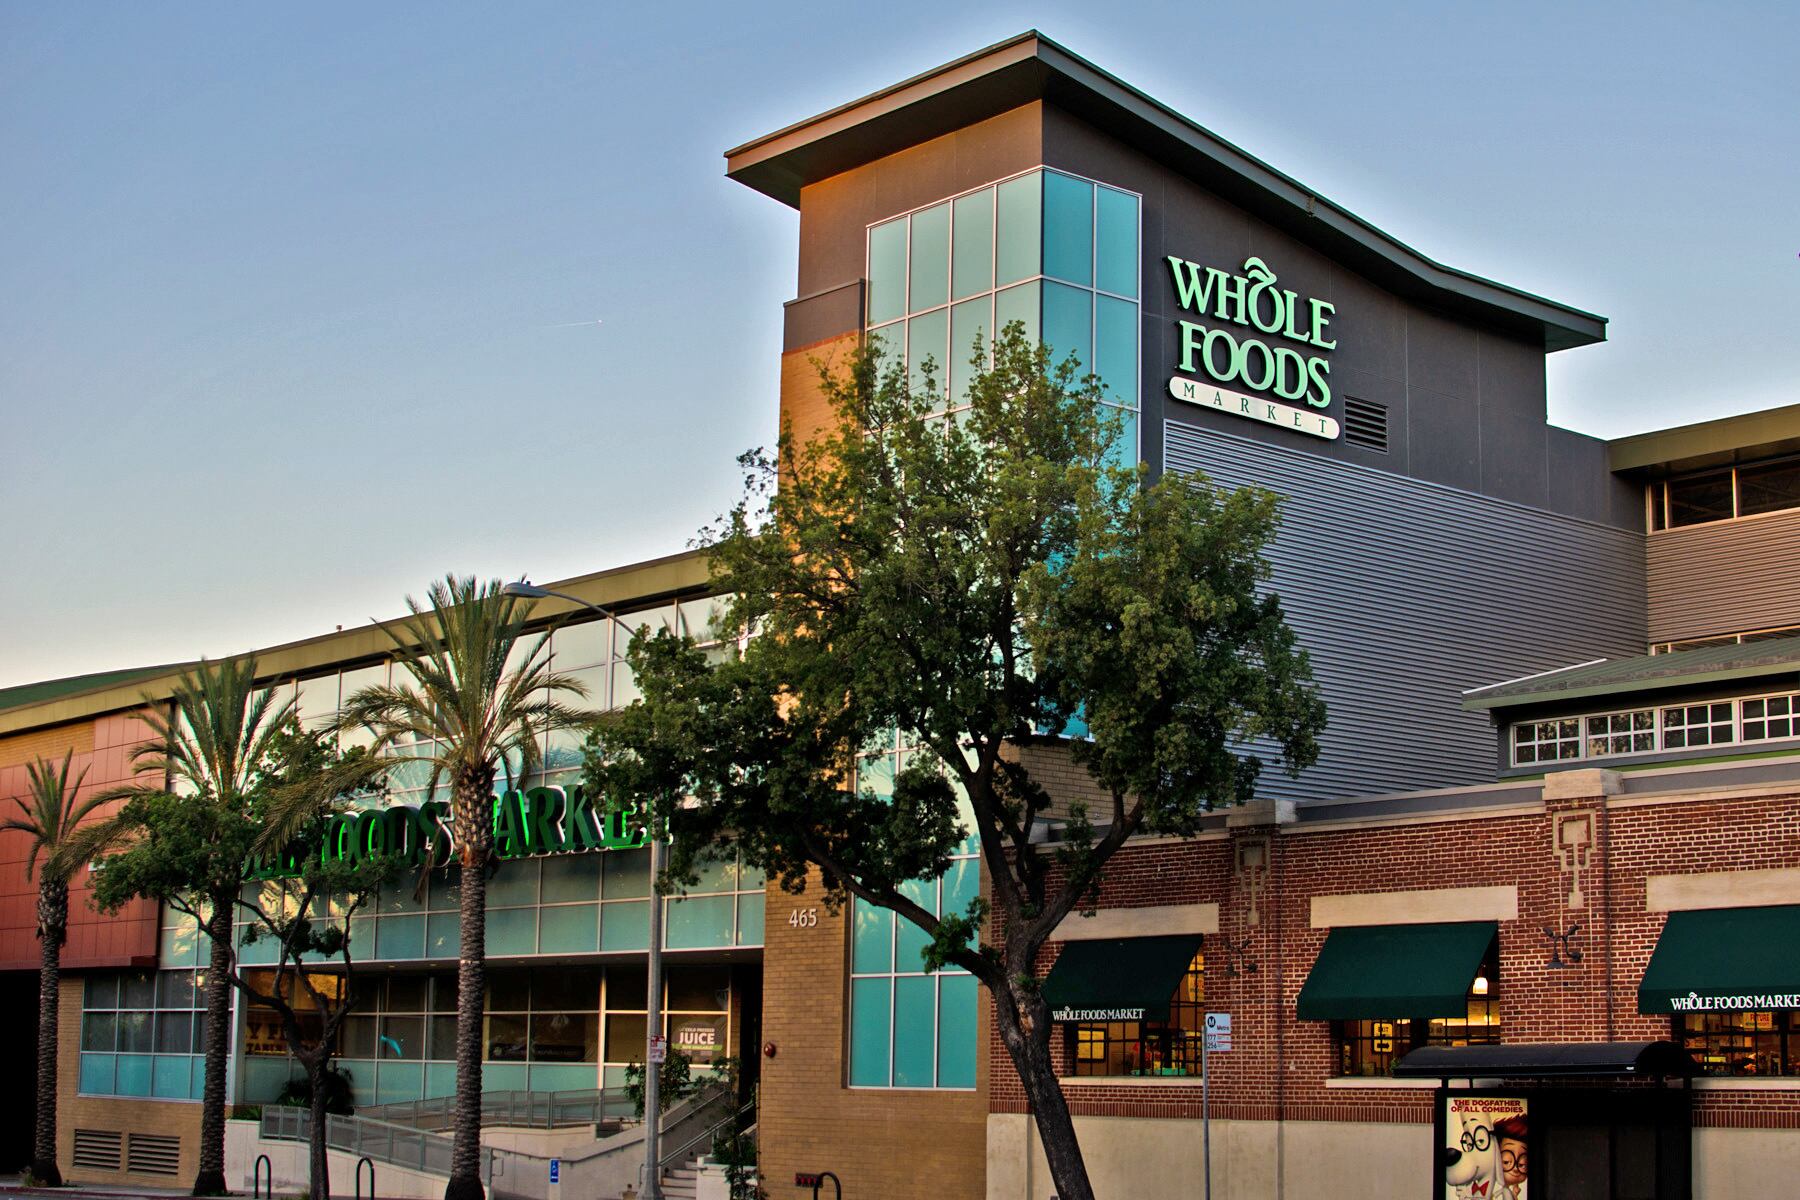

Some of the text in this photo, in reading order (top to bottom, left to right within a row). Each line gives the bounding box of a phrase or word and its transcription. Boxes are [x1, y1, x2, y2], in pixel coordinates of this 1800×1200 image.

[1167, 255, 1337, 350] WHOLE
[1178, 320, 1332, 408] FOODS
[1182, 382, 1328, 434] MARKET
[321, 801, 456, 870] OODS
[788, 908, 818, 928] 465
[1052, 1005, 1144, 1021] WHOLE FOODS MARKET
[1670, 992, 1713, 1010] WHOLE
[1714, 995, 1754, 1009] FOODS
[679, 1032, 715, 1045] JUICE
